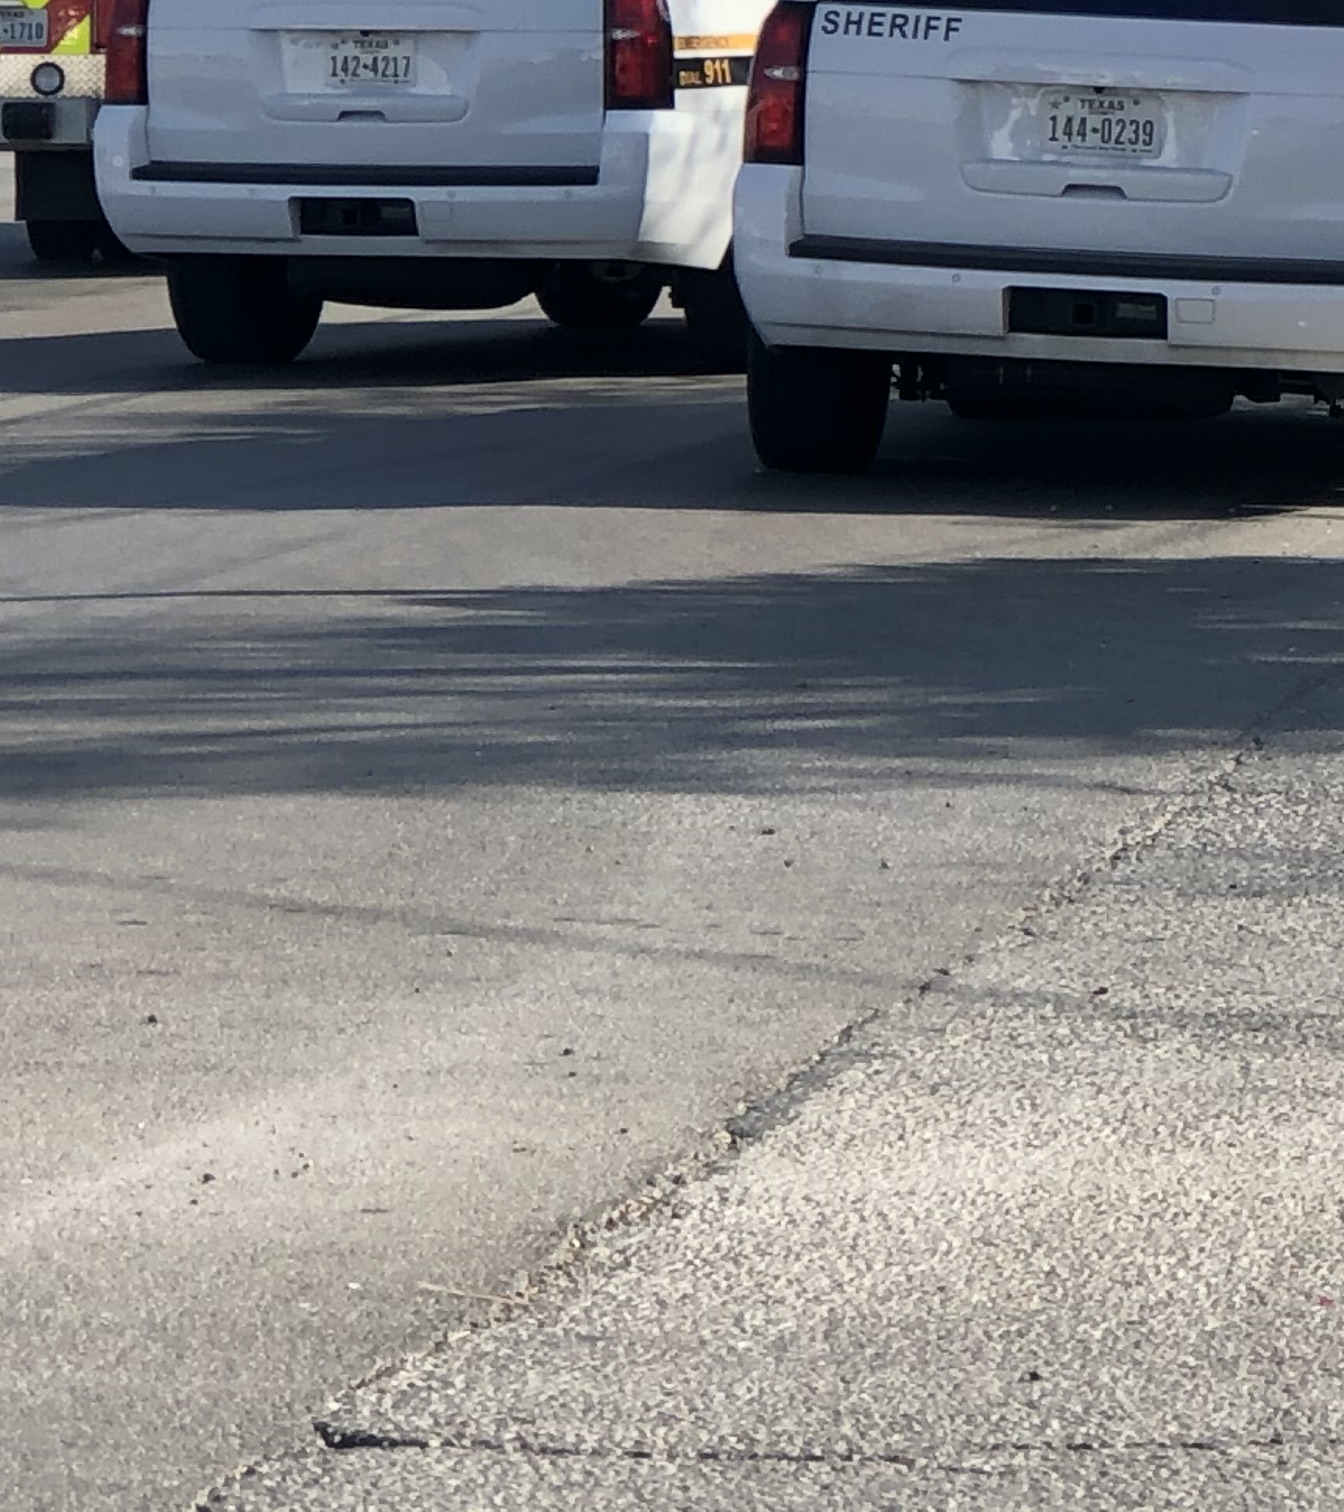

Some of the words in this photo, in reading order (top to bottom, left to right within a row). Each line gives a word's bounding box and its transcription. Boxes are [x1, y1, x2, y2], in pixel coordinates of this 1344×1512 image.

[0, 22, 44, 40] -1710
[821, 9, 963, 42] SHERIFF
[704, 58, 731, 85] 911
[1078, 97, 1125, 111] TEXAS
[1048, 114, 1154, 146] 144-0239
